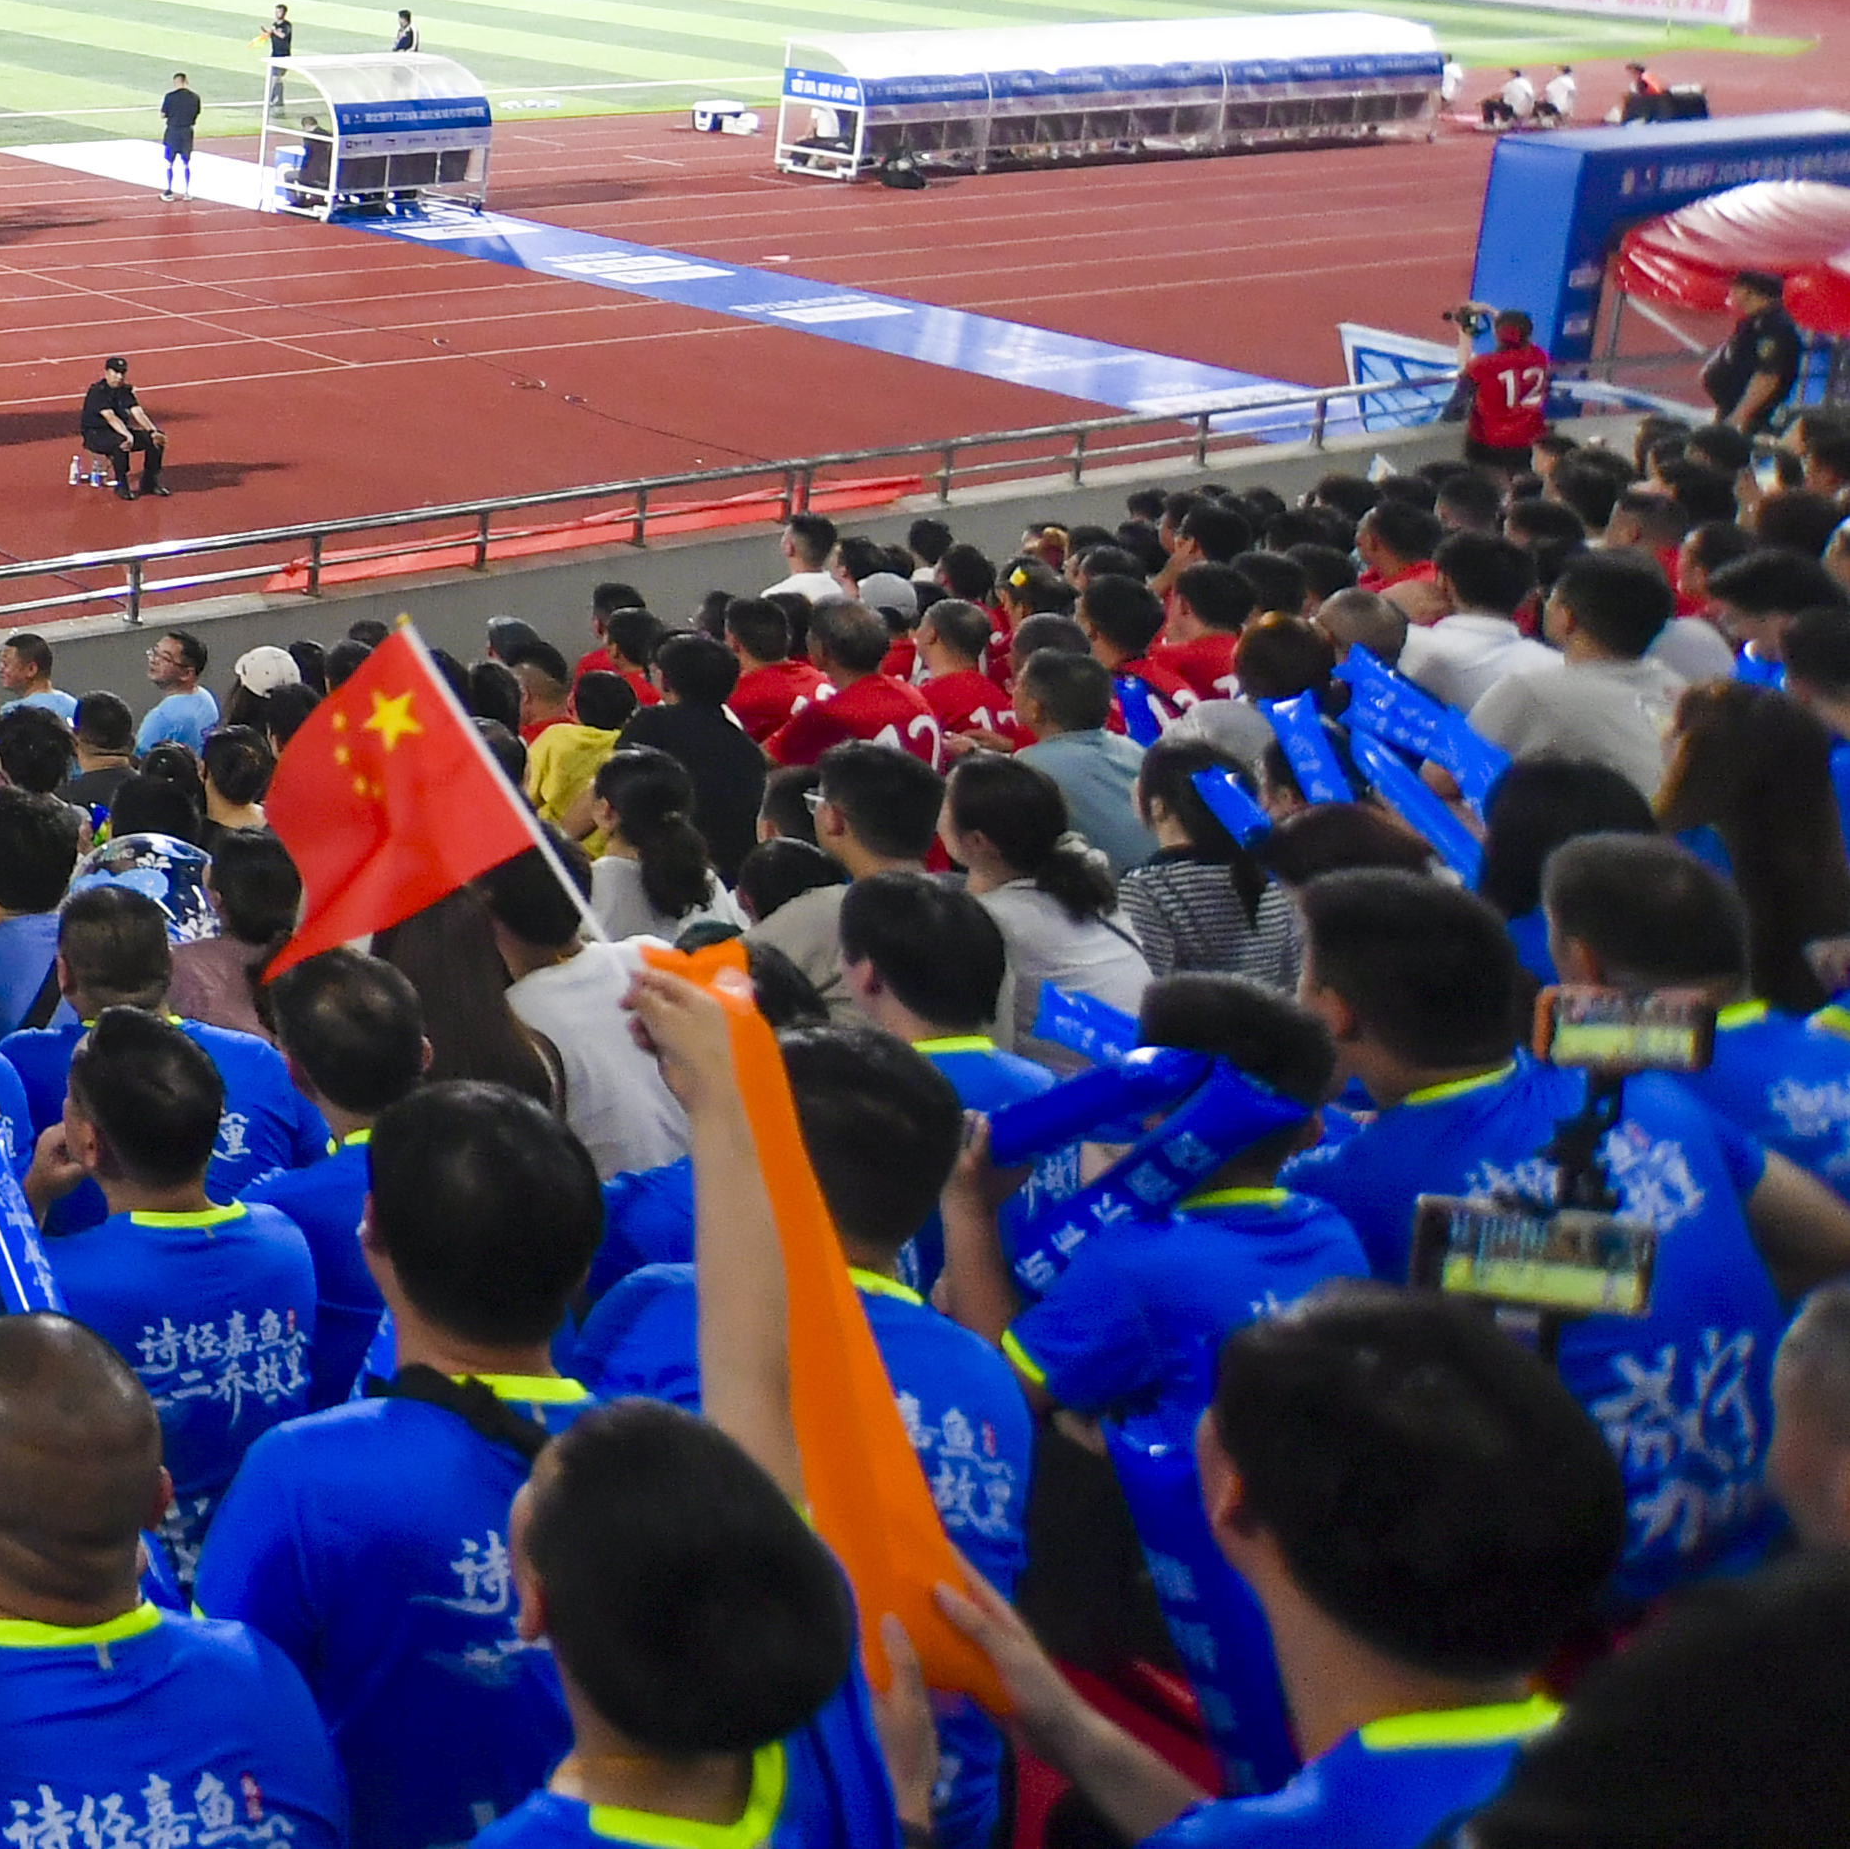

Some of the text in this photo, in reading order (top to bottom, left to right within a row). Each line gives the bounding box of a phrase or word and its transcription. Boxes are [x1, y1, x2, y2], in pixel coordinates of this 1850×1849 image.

[1497, 366, 1546, 409] 12
[135, 1308, 284, 1374] 诗经嘉鱼
[170, 1342, 305, 1416] 二乔故里
